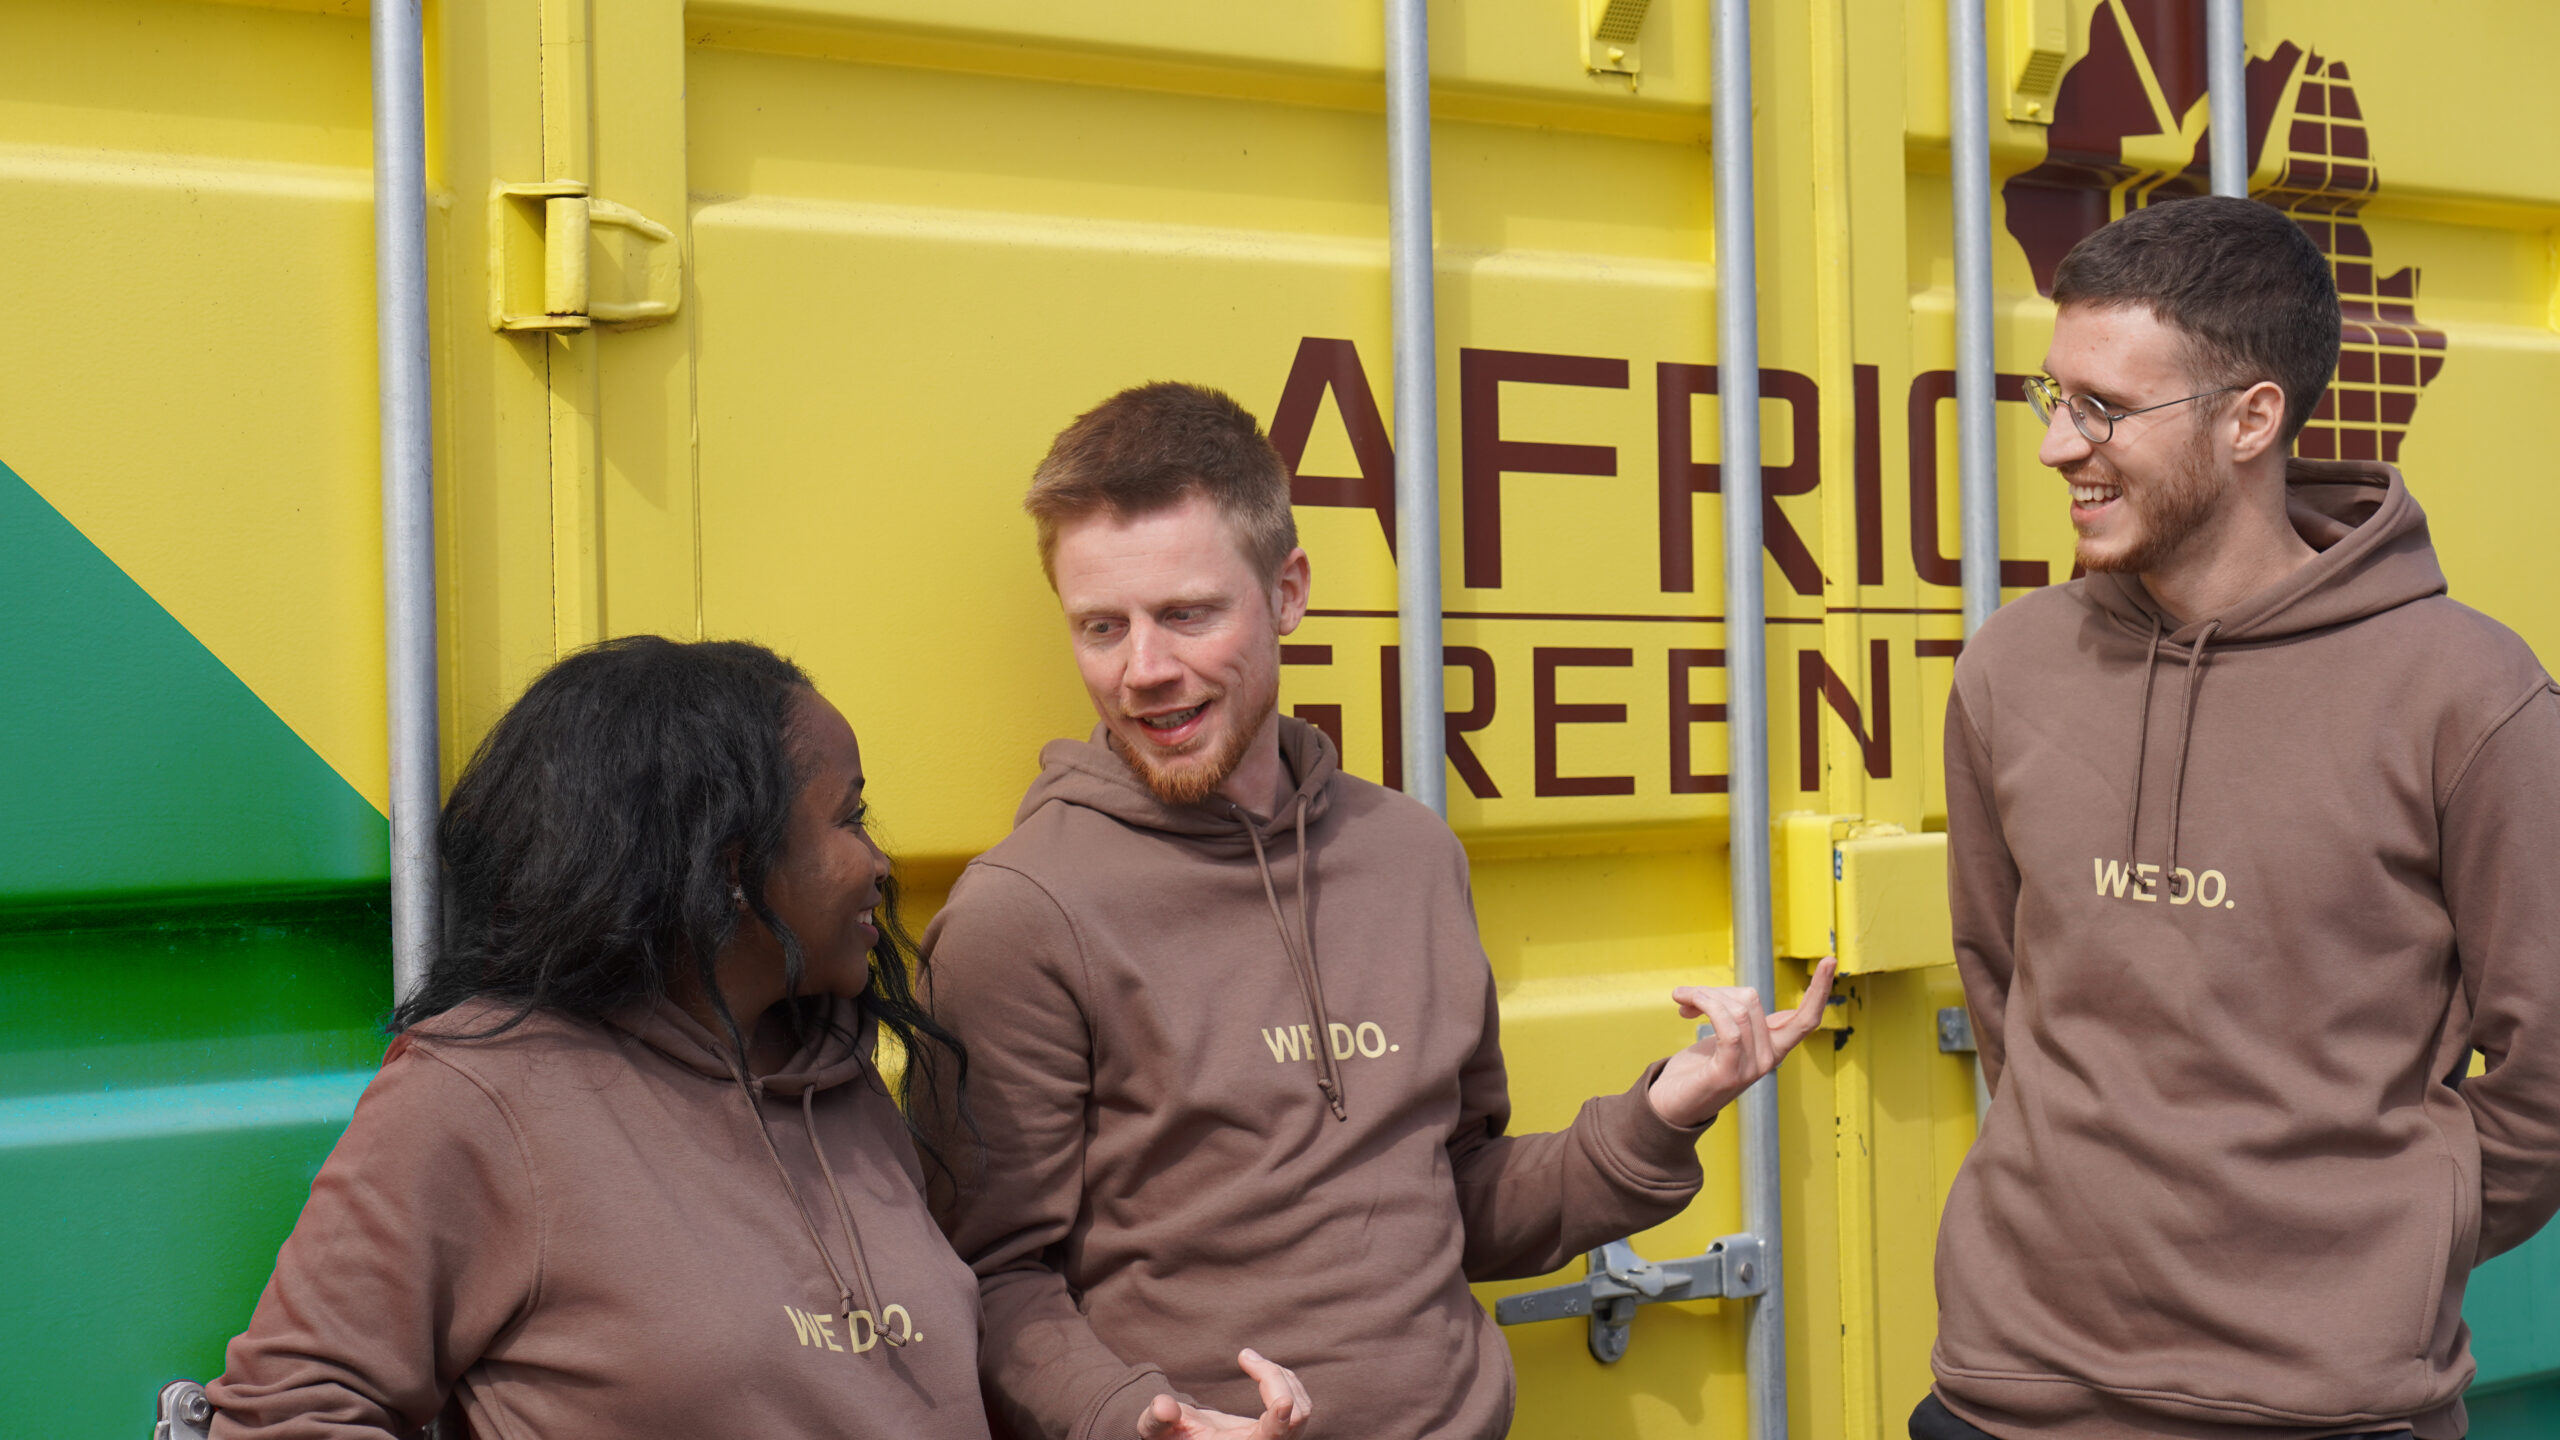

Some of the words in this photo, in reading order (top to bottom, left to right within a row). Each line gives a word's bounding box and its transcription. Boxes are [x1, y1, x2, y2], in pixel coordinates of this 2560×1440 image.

[1269, 336, 2086, 595] AFRIC
[2094, 857, 2160, 902] WE
[2169, 867, 2235, 909] DO.
[1328, 1021, 1400, 1060] DO.
[783, 1305, 844, 1352] WE
[848, 1303, 924, 1353] DO.
